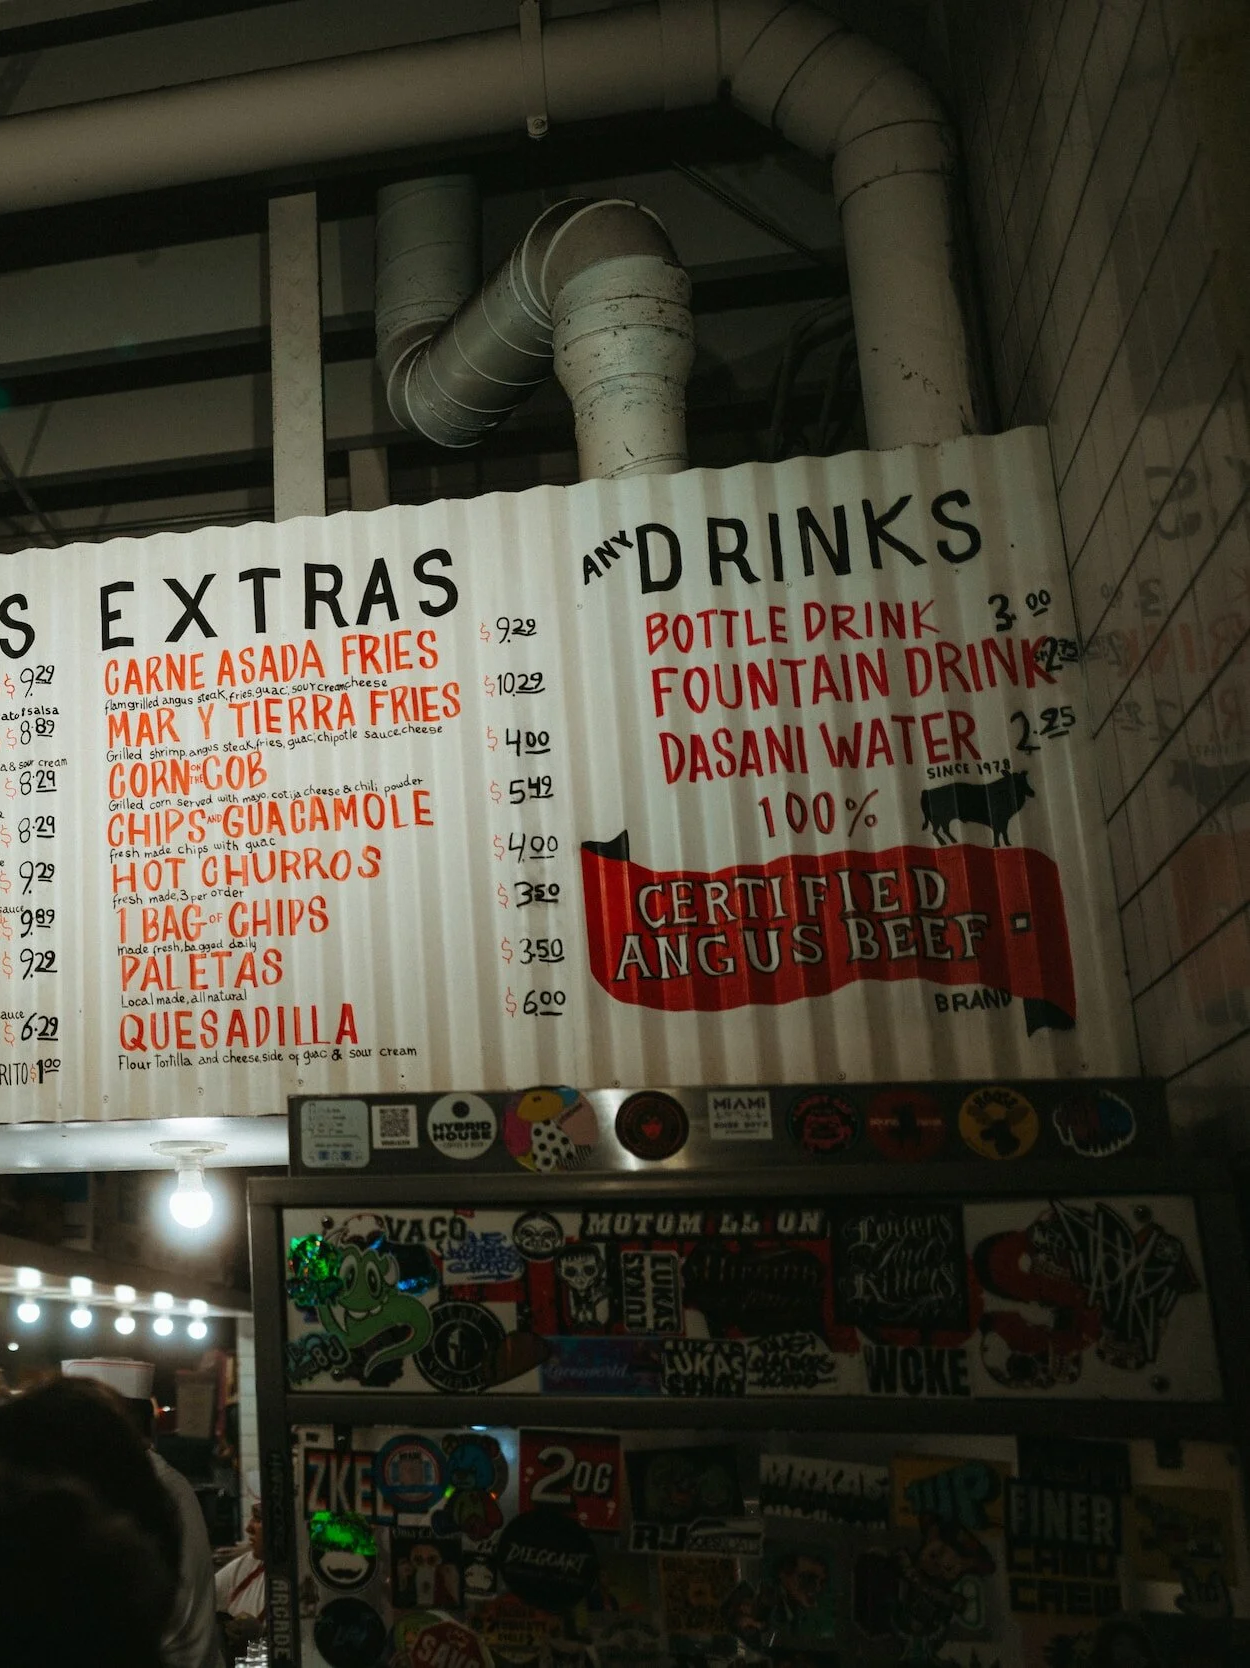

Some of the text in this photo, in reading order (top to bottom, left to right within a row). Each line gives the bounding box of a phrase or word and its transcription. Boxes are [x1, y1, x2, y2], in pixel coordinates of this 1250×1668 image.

[582, 489, 982, 594] ANY DRINKS
[100, 548, 459, 651] EXTRAS
[646, 606, 789, 655] BOTTLE
[805, 600, 941, 642] DRINK
[104, 630, 439, 697] CARNE ASADA FRIES
[651, 646, 889, 718] FOUNTAIN
[903, 635, 1059, 697] DRINK
[108, 681, 462, 750] MAR Y TIERRA FRIES
[162, 696, 193, 709] angus
[38, 758, 67, 767] cream
[107, 728, 357, 761] Grilled angus chipotle
[659, 709, 982, 785] DASANI WATER
[926, 758, 1011, 780] SINCE 1978
[109, 759, 191, 800] CORN
[202, 750, 268, 790] COB
[109, 800, 144, 812] Grilled
[150, 799, 171, 810] corn
[177, 798, 213, 809] served
[217, 792, 238, 804] with
[304, 783, 340, 796] cheese
[355, 780, 377, 792] chili
[384, 775, 423, 795] powder
[107, 790, 434, 848] CHIPS AND GUACAMOLE
[757, 789, 879, 838] 100%
[110, 837, 275, 863] fresh made chips with guac
[111, 845, 382, 894] HOT CHURROS
[113, 889, 244, 909] fresh order
[116, 895, 330, 944] 1 BAG OF CHIPS
[637, 865, 948, 930] CERTIFIED
[117, 938, 256, 956] made daily
[121, 948, 284, 992] PALETAS
[616, 912, 990, 983] ANGUS BEEF
[935, 989, 1012, 1013] BRAND
[119, 1002, 359, 1053] QUESADILLA
[119, 1055, 152, 1071] Flour
[198, 1051, 219, 1065] and
[349, 1047, 372, 1058] sour
[380, 1046, 417, 1057] cream
[434, 1132, 491, 1141] HOUSE
[864, 1346, 968, 1396] WOKE
